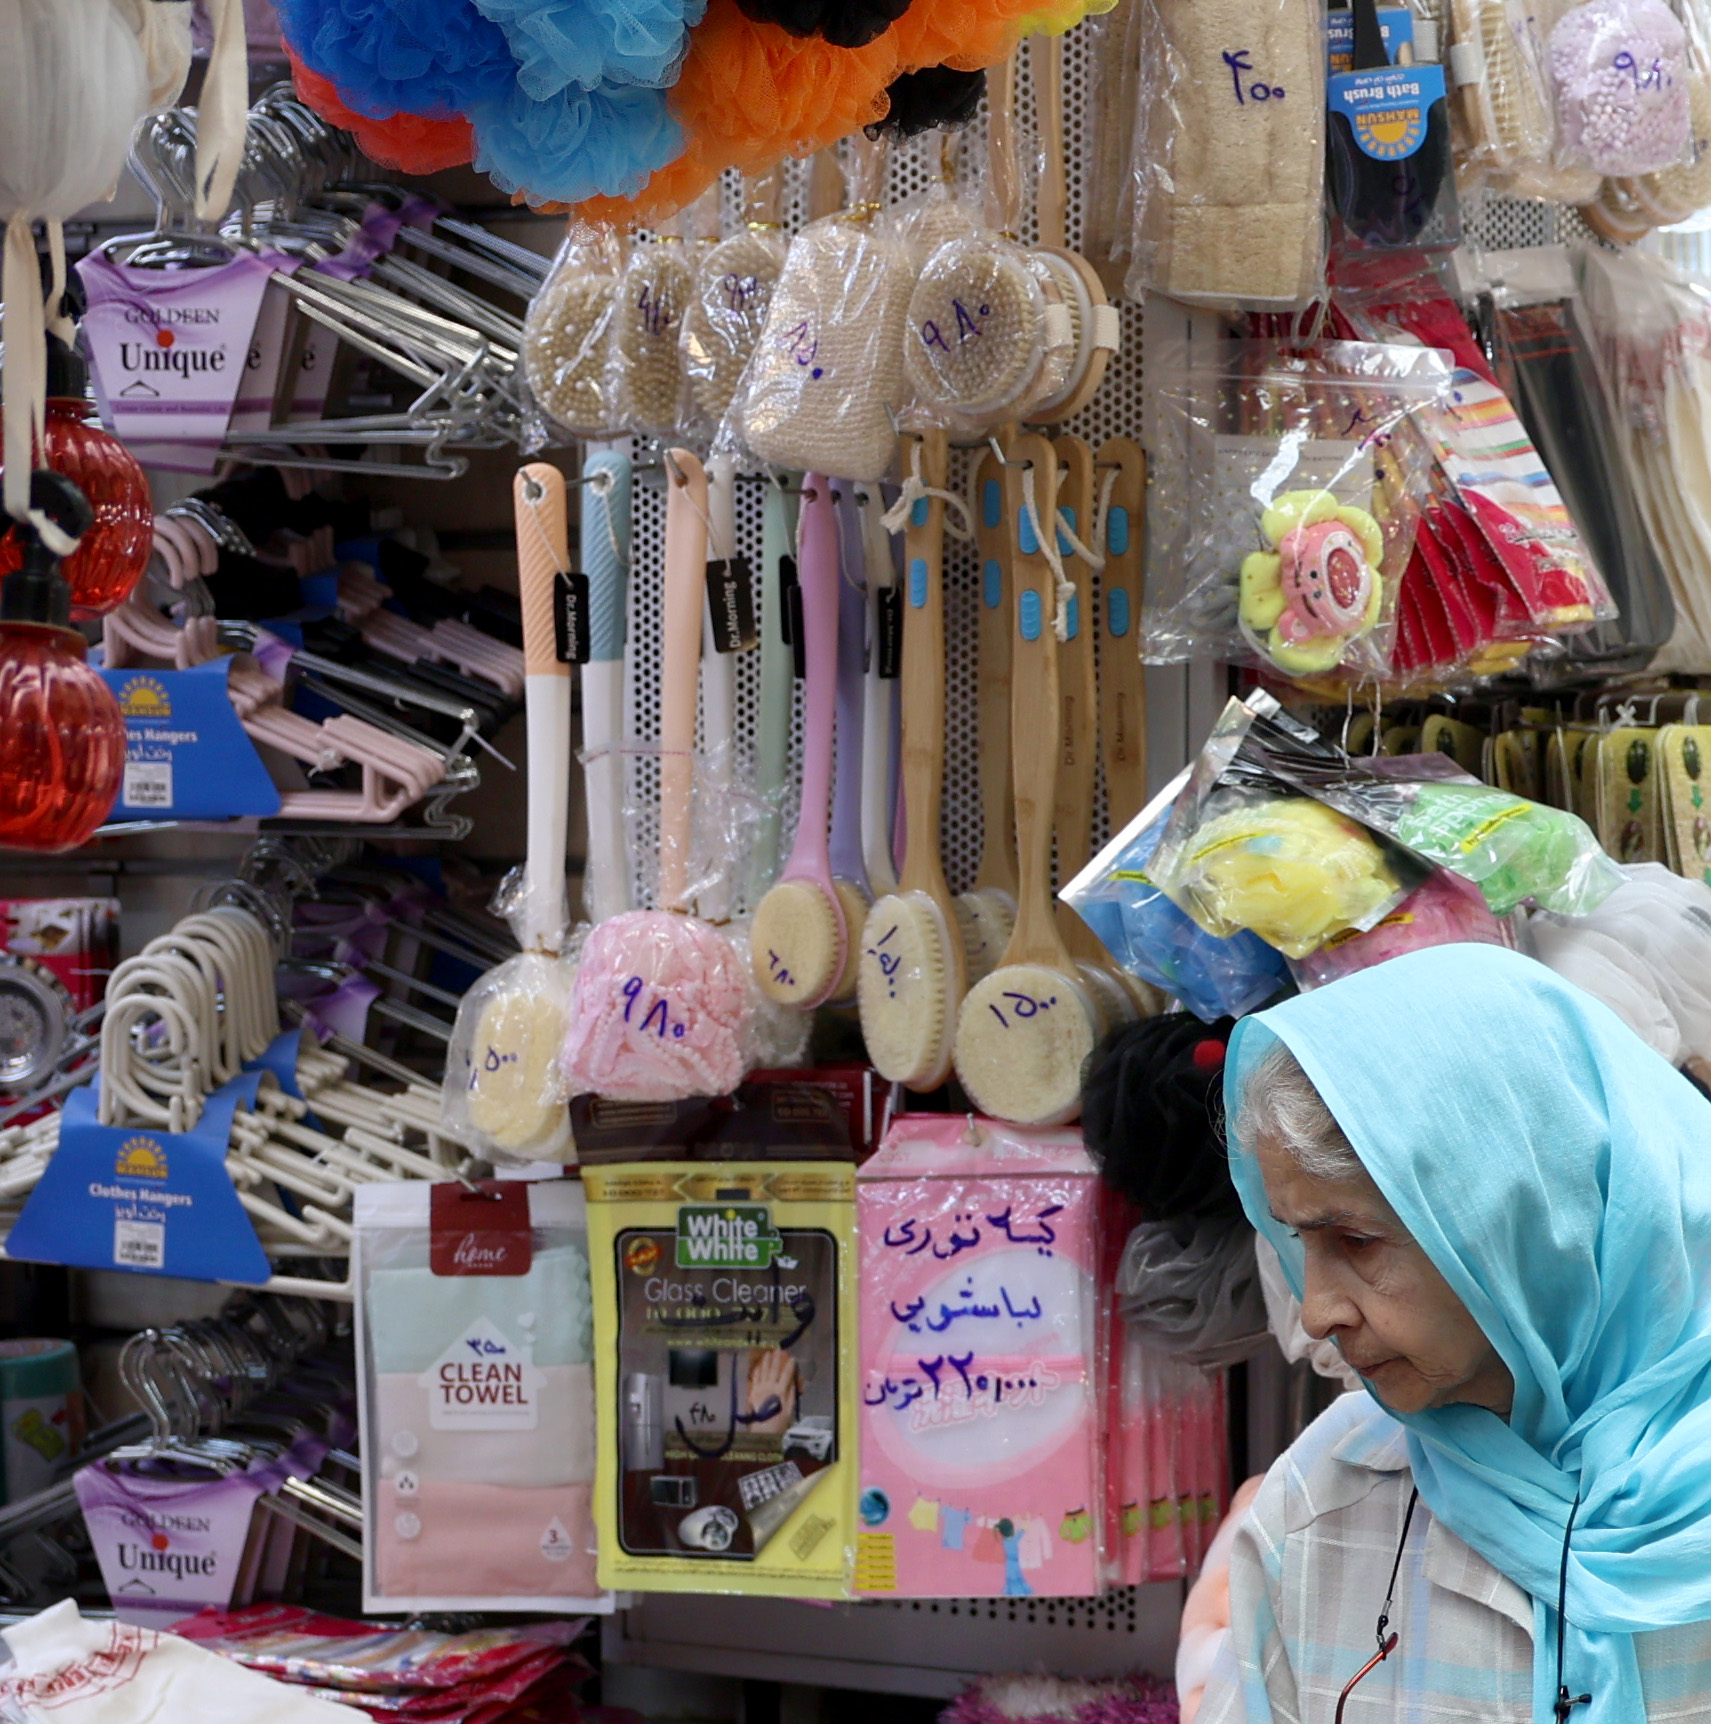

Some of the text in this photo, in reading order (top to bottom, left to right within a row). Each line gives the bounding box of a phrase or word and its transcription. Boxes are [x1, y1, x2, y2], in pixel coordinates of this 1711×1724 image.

[1344, 82, 1420, 104] Bath Brush
[119, 342, 225, 378] Unique
[726, 580, 743, 650] Dr.Morning
[145, 729, 198, 746] Hangers
[89, 1182, 193, 1207] Clothes Hangers
[687, 1213, 759, 1237] White
[453, 1232, 508, 1265] home
[687, 1237, 759, 1261] White
[644, 1277, 807, 1303] Glass Cleaner
[440, 1362, 522, 1382] CLEAN
[440, 1385, 529, 1405] TOWEL
[117, 1542, 217, 1581] Unique
